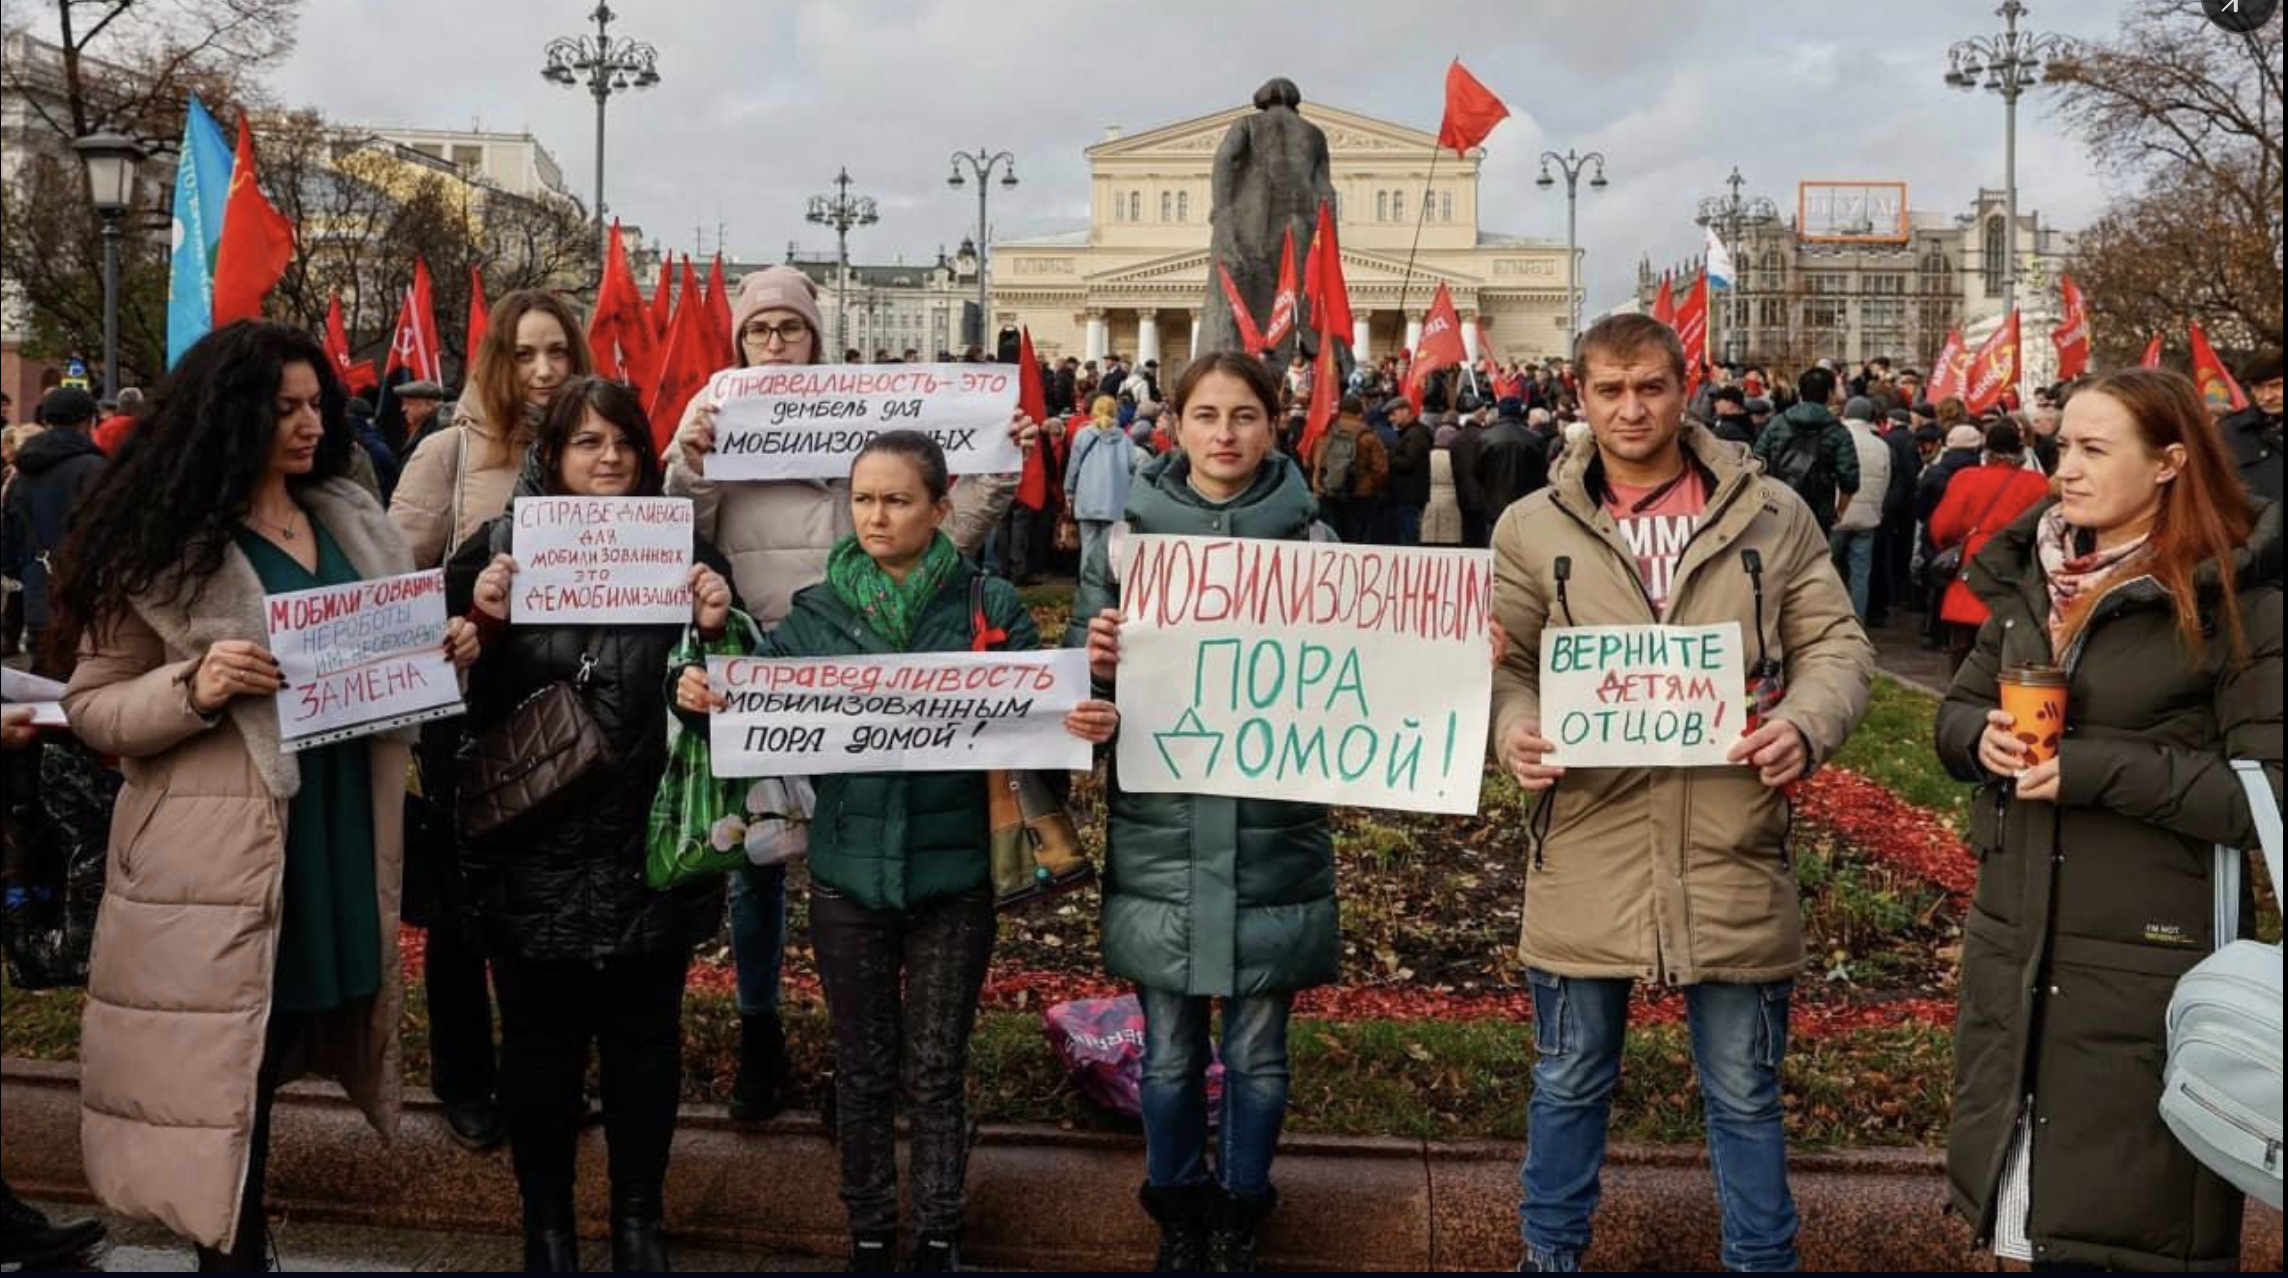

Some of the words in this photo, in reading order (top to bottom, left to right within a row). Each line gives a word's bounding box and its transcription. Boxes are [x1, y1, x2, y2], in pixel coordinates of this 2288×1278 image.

[721, 428, 977, 454] МОБИЛИЗОЫХ
[579, 529, 617, 545] ДЛЯ
[574, 569, 610, 583] ЭТО
[1119, 540, 1491, 643] МОБИЛИЗОВАННЫМ
[1551, 630, 1724, 673] ВЕРНИТЕ
[295, 660, 427, 721] ЗАМЕНА
[1194, 638, 1368, 716] ПОРА
[1596, 669, 1716, 704] ДЕТЯМ
[717, 690, 1034, 719] МОБИЛИЗОВАННЫМ
[1562, 701, 1726, 746] ОТЦОВ!
[743, 725, 825, 753] ПОРА
[1153, 707, 1457, 797] ДОМОЙ!
